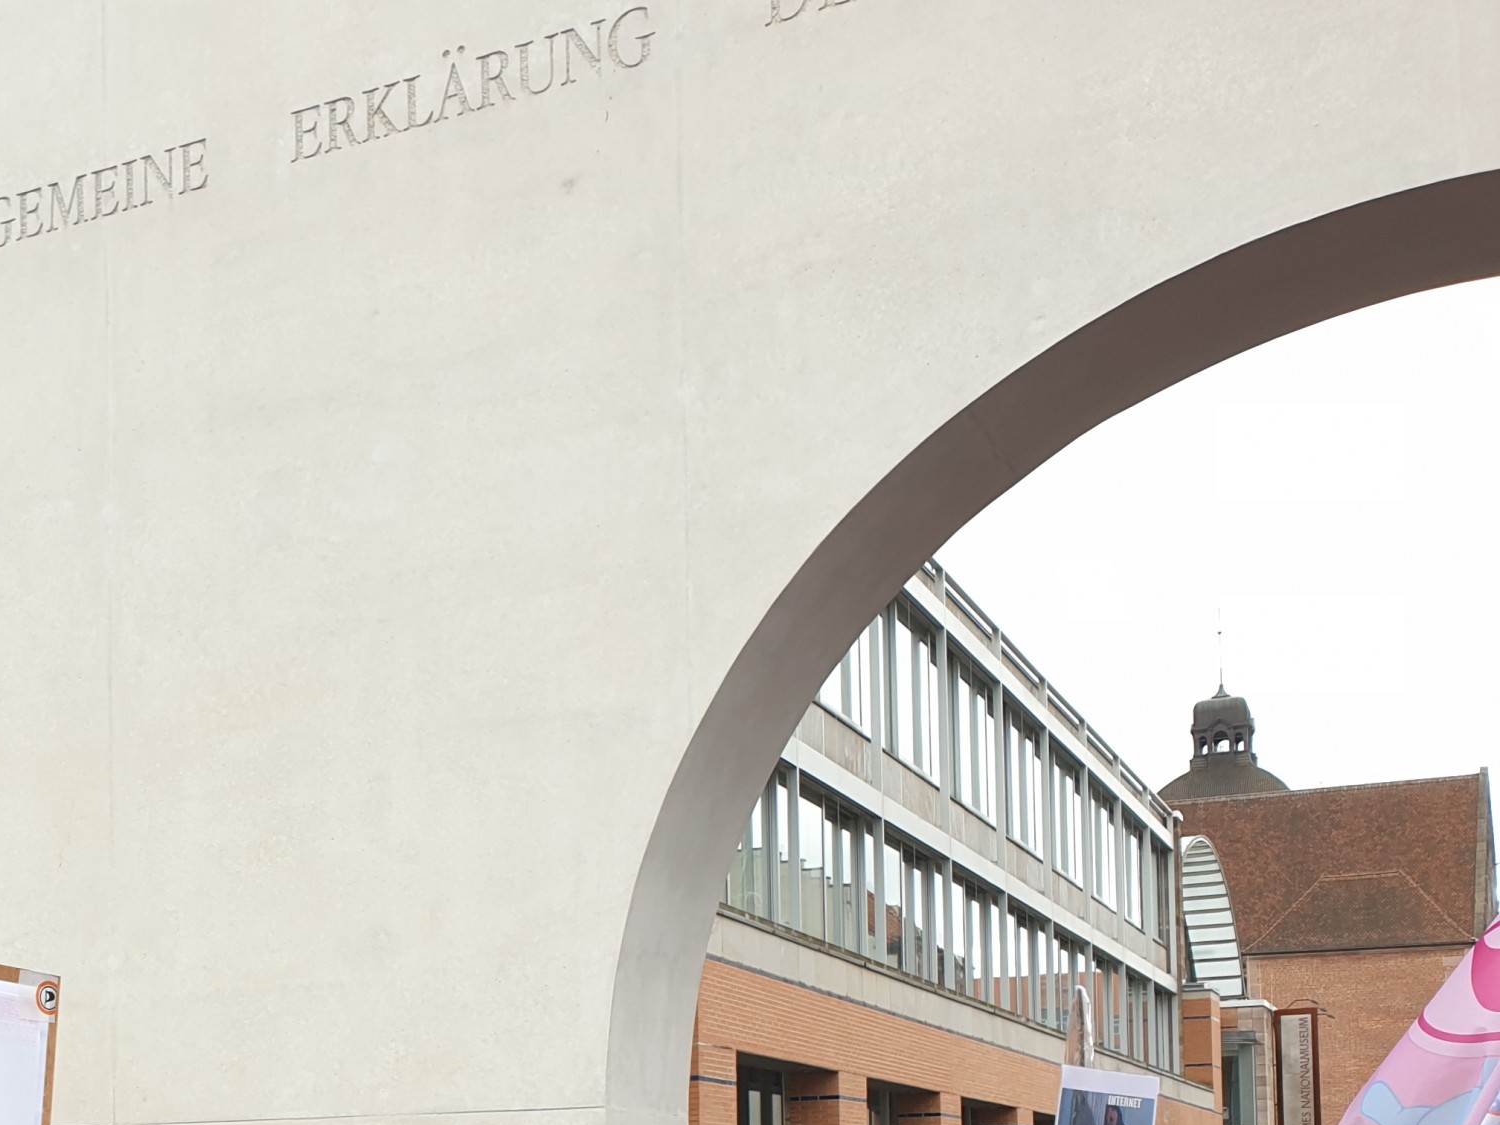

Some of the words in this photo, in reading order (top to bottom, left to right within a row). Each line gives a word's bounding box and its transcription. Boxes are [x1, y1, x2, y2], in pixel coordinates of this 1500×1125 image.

[290, 6, 656, 163] ERKLÄRUNG
[1108, 1095, 1142, 1109] INTERNET
[1298, 1016, 1312, 1109] NATIONALMUSEUM
